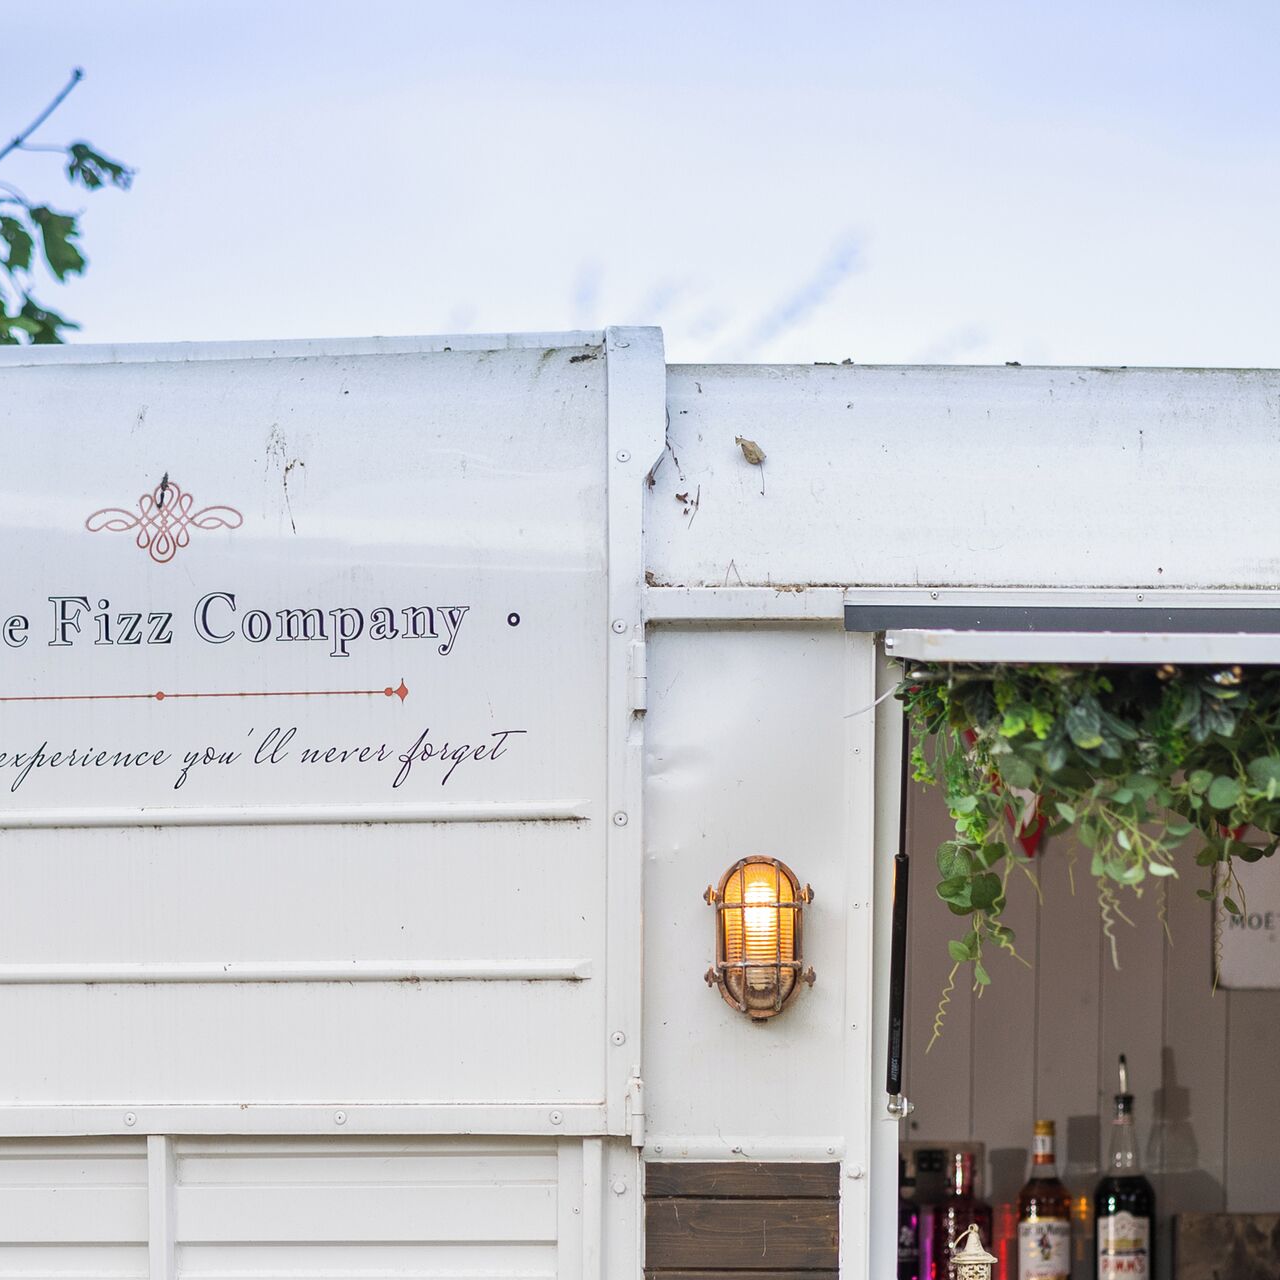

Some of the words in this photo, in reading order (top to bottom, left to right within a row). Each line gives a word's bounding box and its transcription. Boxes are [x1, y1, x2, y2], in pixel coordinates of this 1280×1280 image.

[47, 595, 174, 647] Fizz
[193, 591, 471, 658] Company
[174, 727, 297, 790] you'll
[301, 743, 394, 767] never
[393, 728, 528, 789] forget
